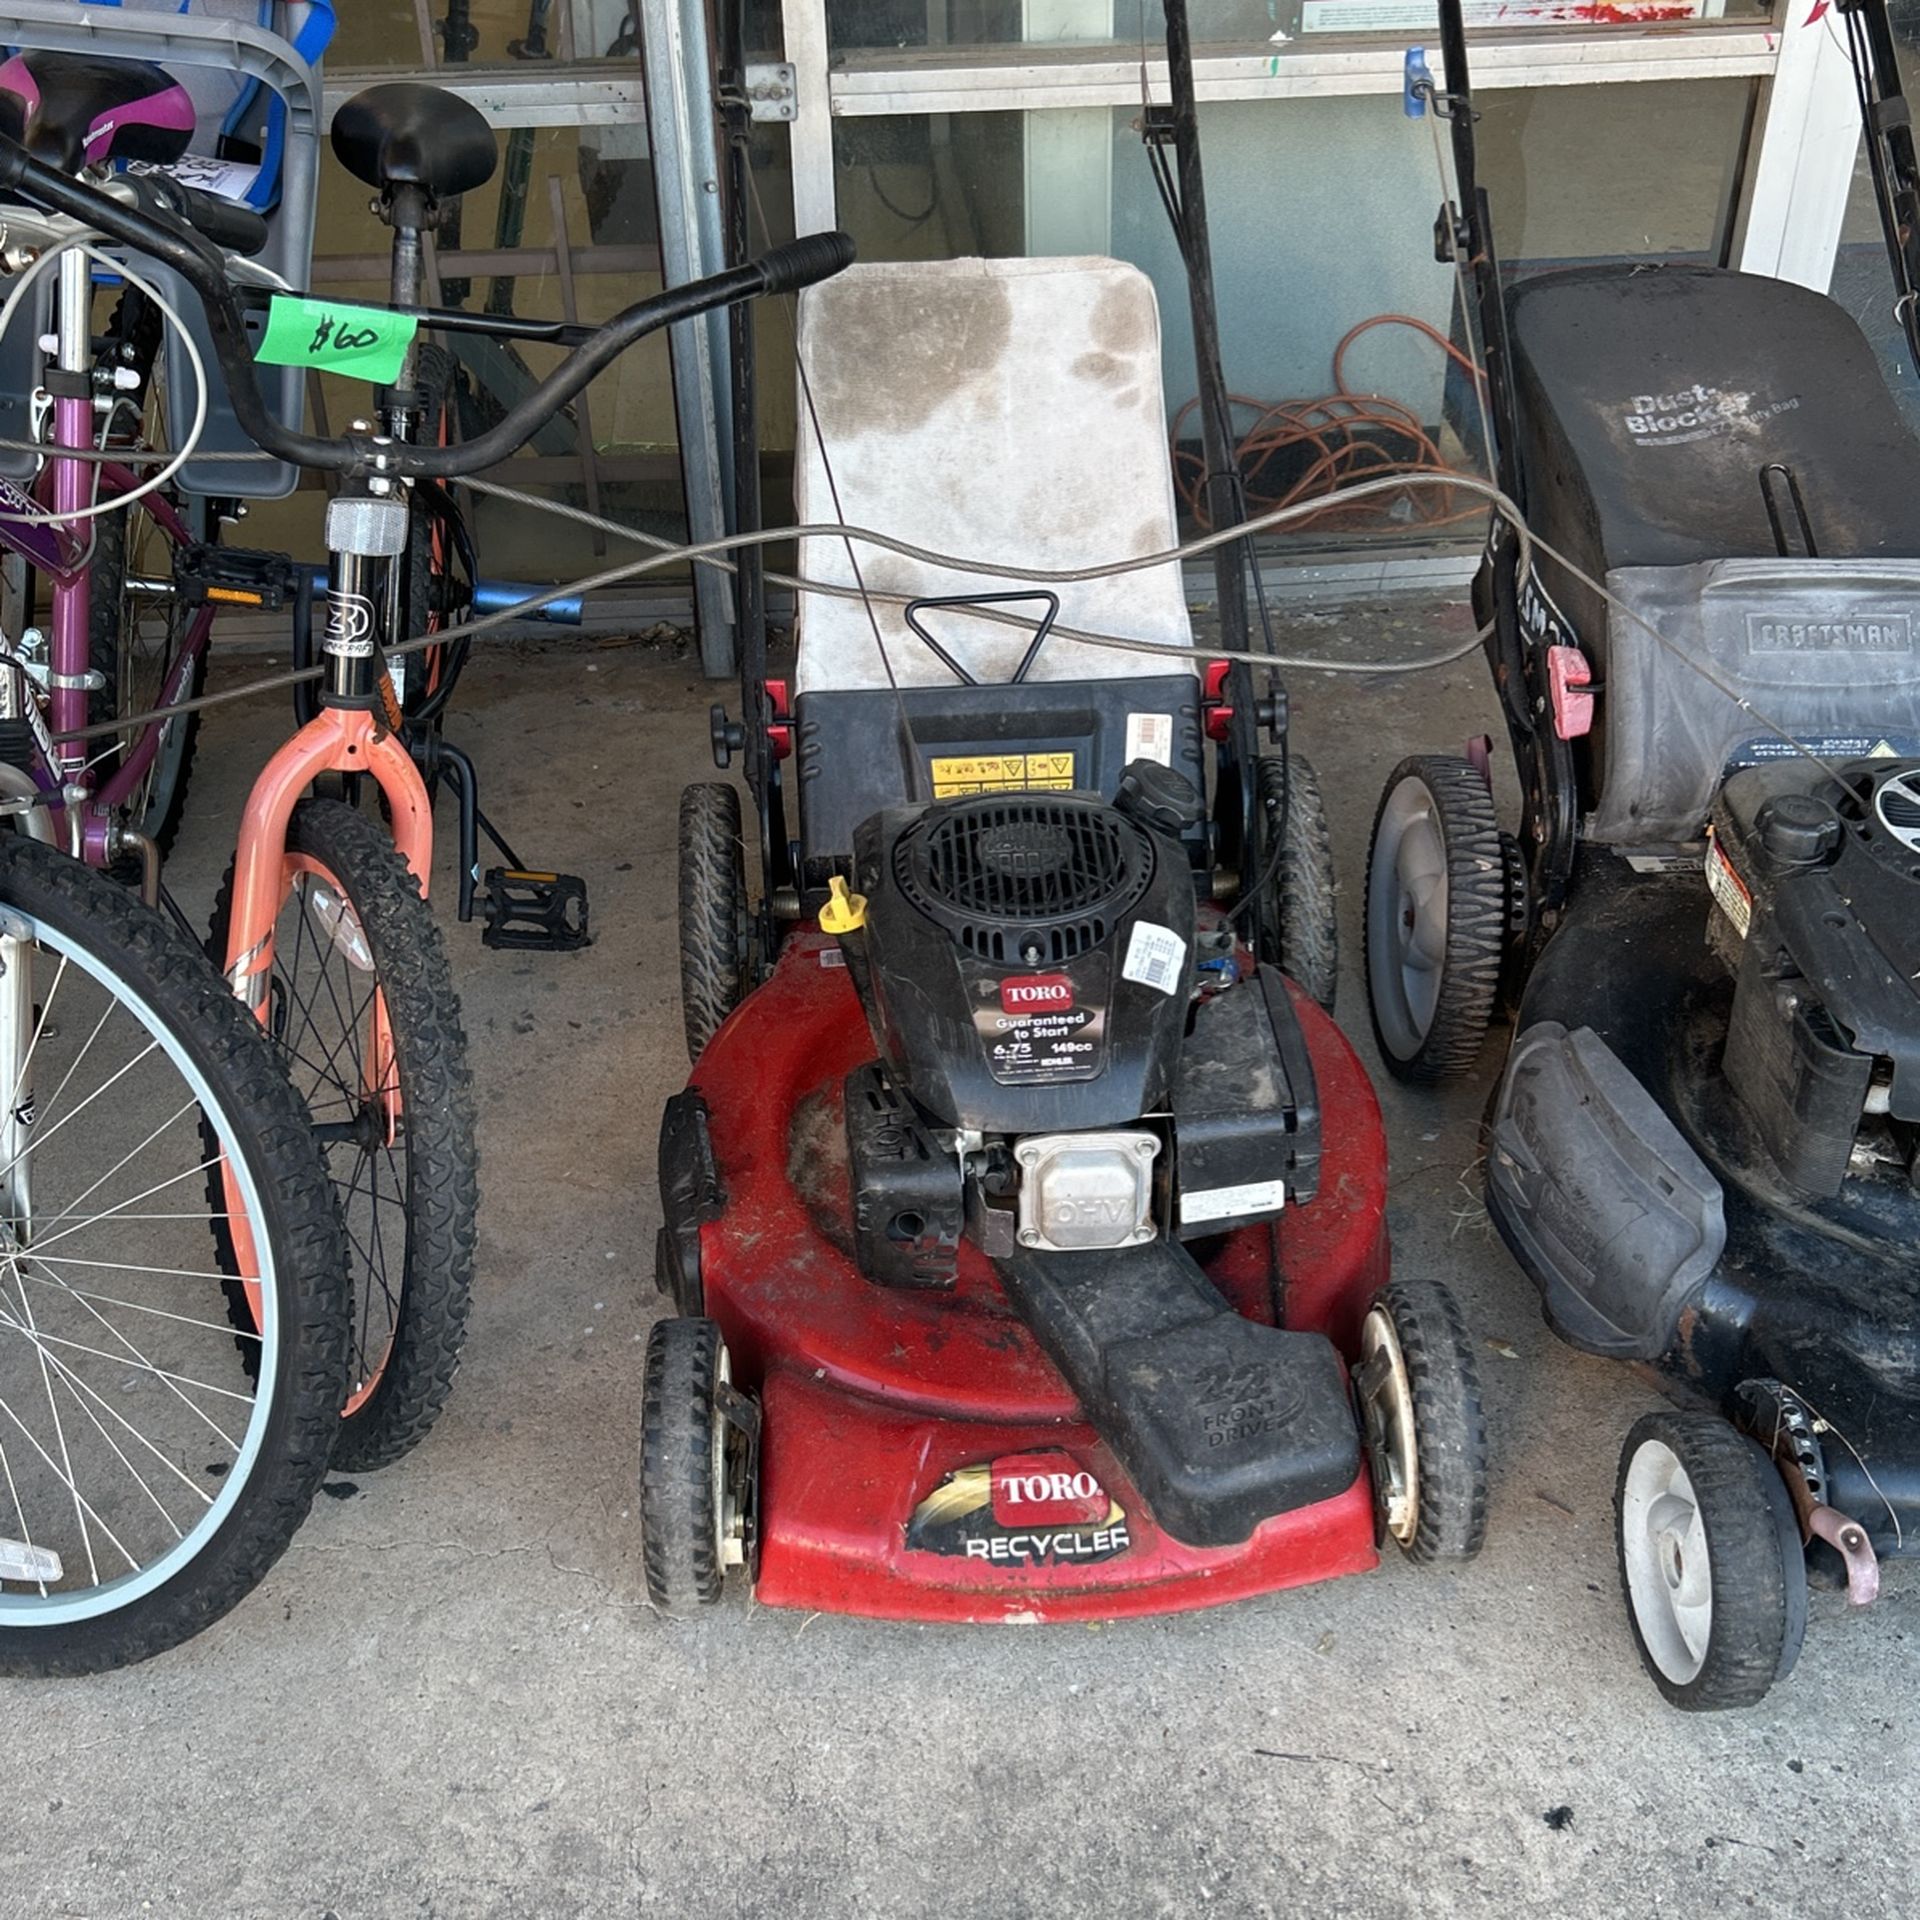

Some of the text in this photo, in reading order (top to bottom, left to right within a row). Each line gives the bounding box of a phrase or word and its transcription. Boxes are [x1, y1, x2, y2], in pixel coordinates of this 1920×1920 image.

[309, 313, 379, 354] $60
[1770, 398, 1800, 414] Bag
[1761, 624, 1899, 645] CRAFTSMAN
[1007, 985, 1067, 1002] TORO
[996, 1013, 1085, 1029] Guaranteed
[1014, 1026, 1069, 1039] to Start
[993, 1042, 1093, 1055] 6.75 149cc
[1056, 1199, 1128, 1224] OHV
[1203, 1401, 1276, 1430] FRONT
[1209, 1419, 1274, 1447] DRIVE
[1001, 1472, 1100, 1503] TORO
[967, 1527, 1130, 1560] RECYCLER
